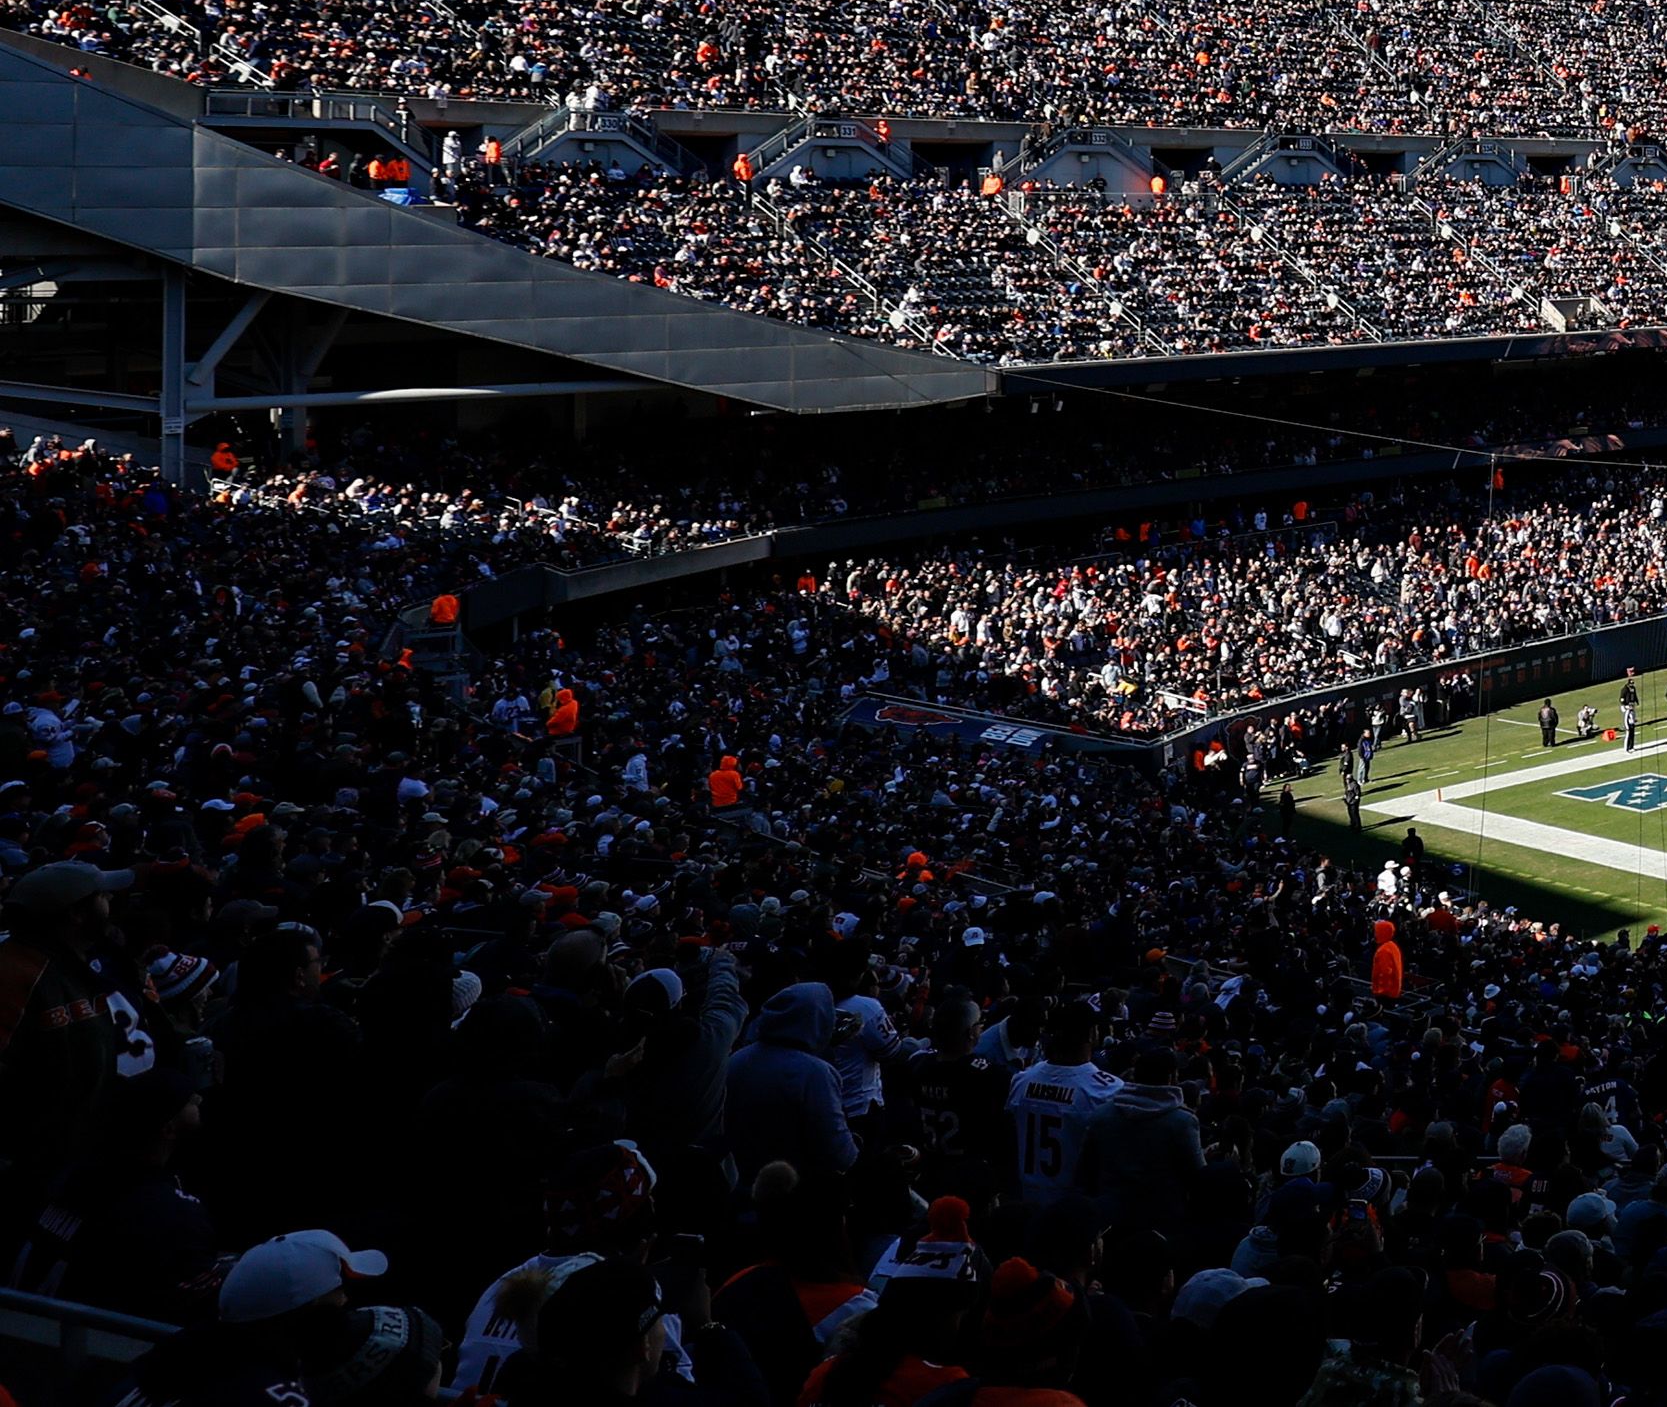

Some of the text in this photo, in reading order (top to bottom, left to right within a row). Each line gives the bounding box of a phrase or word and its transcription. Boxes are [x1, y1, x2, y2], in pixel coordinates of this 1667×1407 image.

[601, 117, 618, 130] 330
[841, 125, 857, 138] 331
[1025, 1081, 1073, 1105] MARSHALL
[1584, 1081, 1618, 1096] PAYTON
[920, 1106, 963, 1156] 52
[1022, 1111, 1062, 1178] 15
